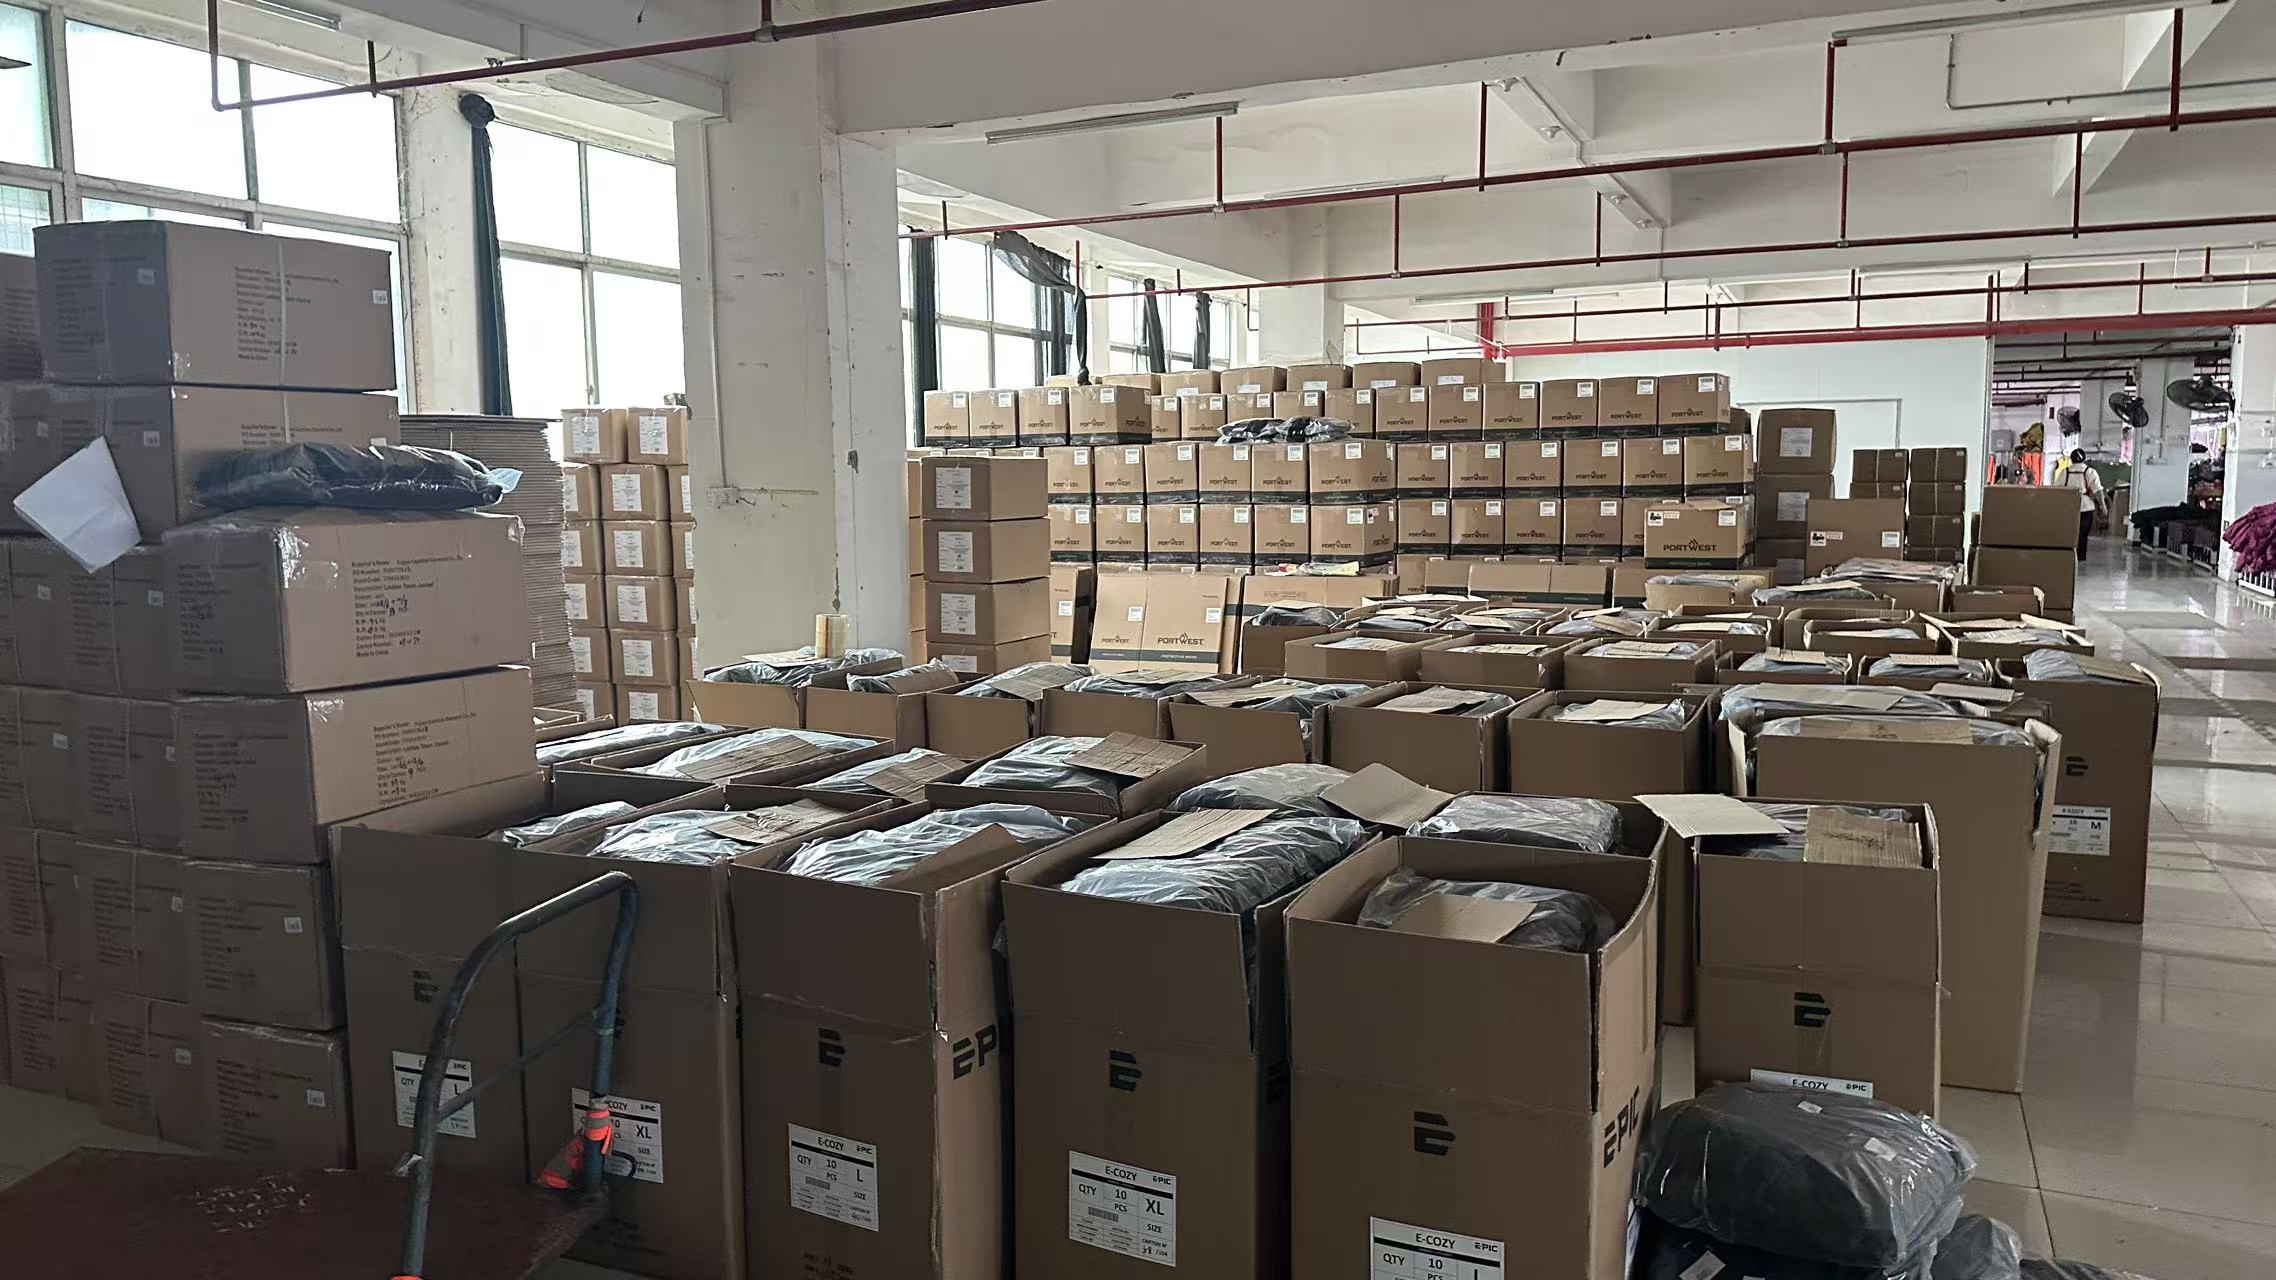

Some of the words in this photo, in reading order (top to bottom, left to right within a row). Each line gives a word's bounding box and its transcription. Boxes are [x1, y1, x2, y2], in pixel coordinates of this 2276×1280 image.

[1663, 541, 1717, 551] PORTWEST
[1157, 634, 1204, 645] PORTWEST
[2091, 821, 2101, 830] M
[953, 1024, 997, 1080] EP
[401, 1077, 414, 1086] QTY
[1846, 1083, 1866, 1091] EPIC
[636, 1125, 651, 1139] XL
[1603, 1085, 1640, 1168] EPIC
[817, 1137, 844, 1151] E-COZY
[797, 1154, 812, 1165] QTY
[826, 1159, 836, 1169] 10
[856, 1168, 863, 1182] L
[826, 1172, 837, 1181] PCS
[1105, 1165, 1137, 1181] E-COZY
[1152, 1175, 1171, 1185] EPIC
[853, 1191, 866, 1201] SIZE
[1078, 1184, 1097, 1196] QTY
[1115, 1189, 1127, 1200] 10
[1146, 1199, 1164, 1215] XL
[1115, 1203, 1128, 1213] PCS
[1147, 1223, 1162, 1234] SIZE
[1416, 1233, 1456, 1249] E-COZY
[1474, 1242, 1498, 1253] EPIC
[1383, 1253, 1405, 1266] QTY
[1428, 1258, 1443, 1270] 10
